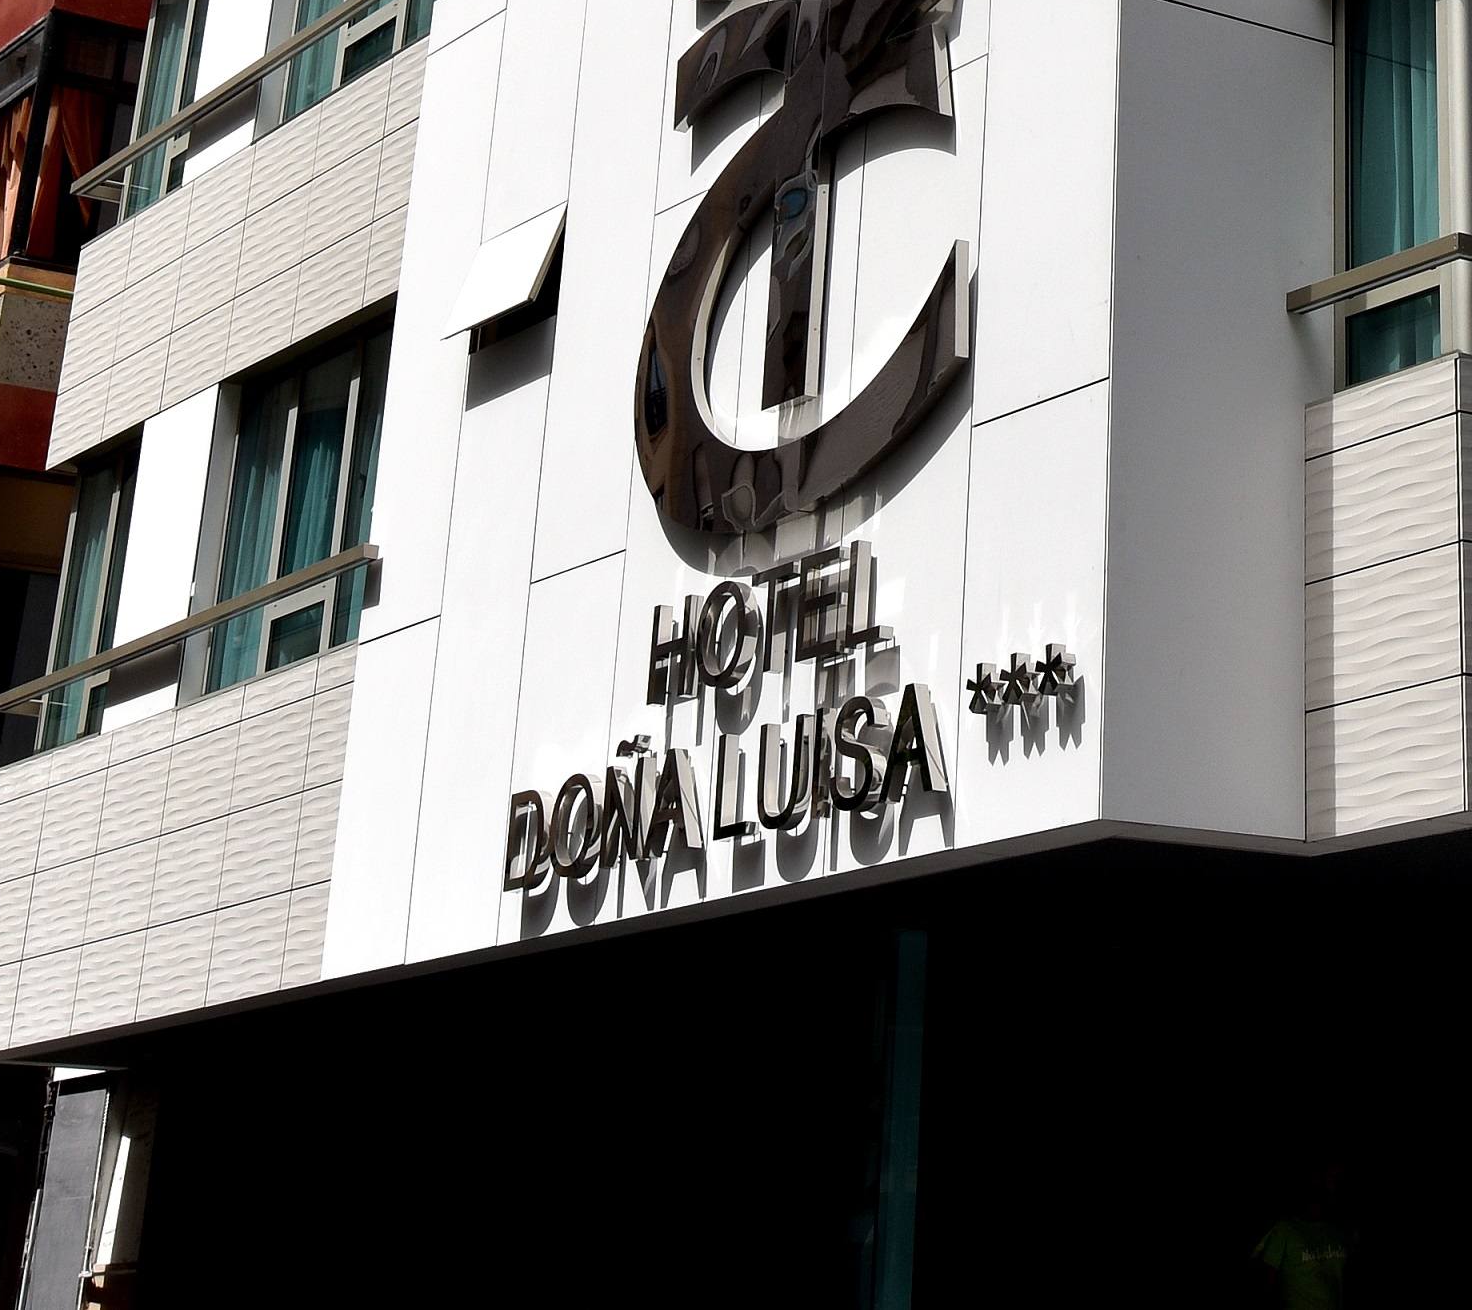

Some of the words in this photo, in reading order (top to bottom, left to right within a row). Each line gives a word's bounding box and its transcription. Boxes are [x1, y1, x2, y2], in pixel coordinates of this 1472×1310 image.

[647, 540, 895, 706] HOTEL
[503, 734, 703, 891] DOÑA
[713, 683, 948, 841] LUISA
